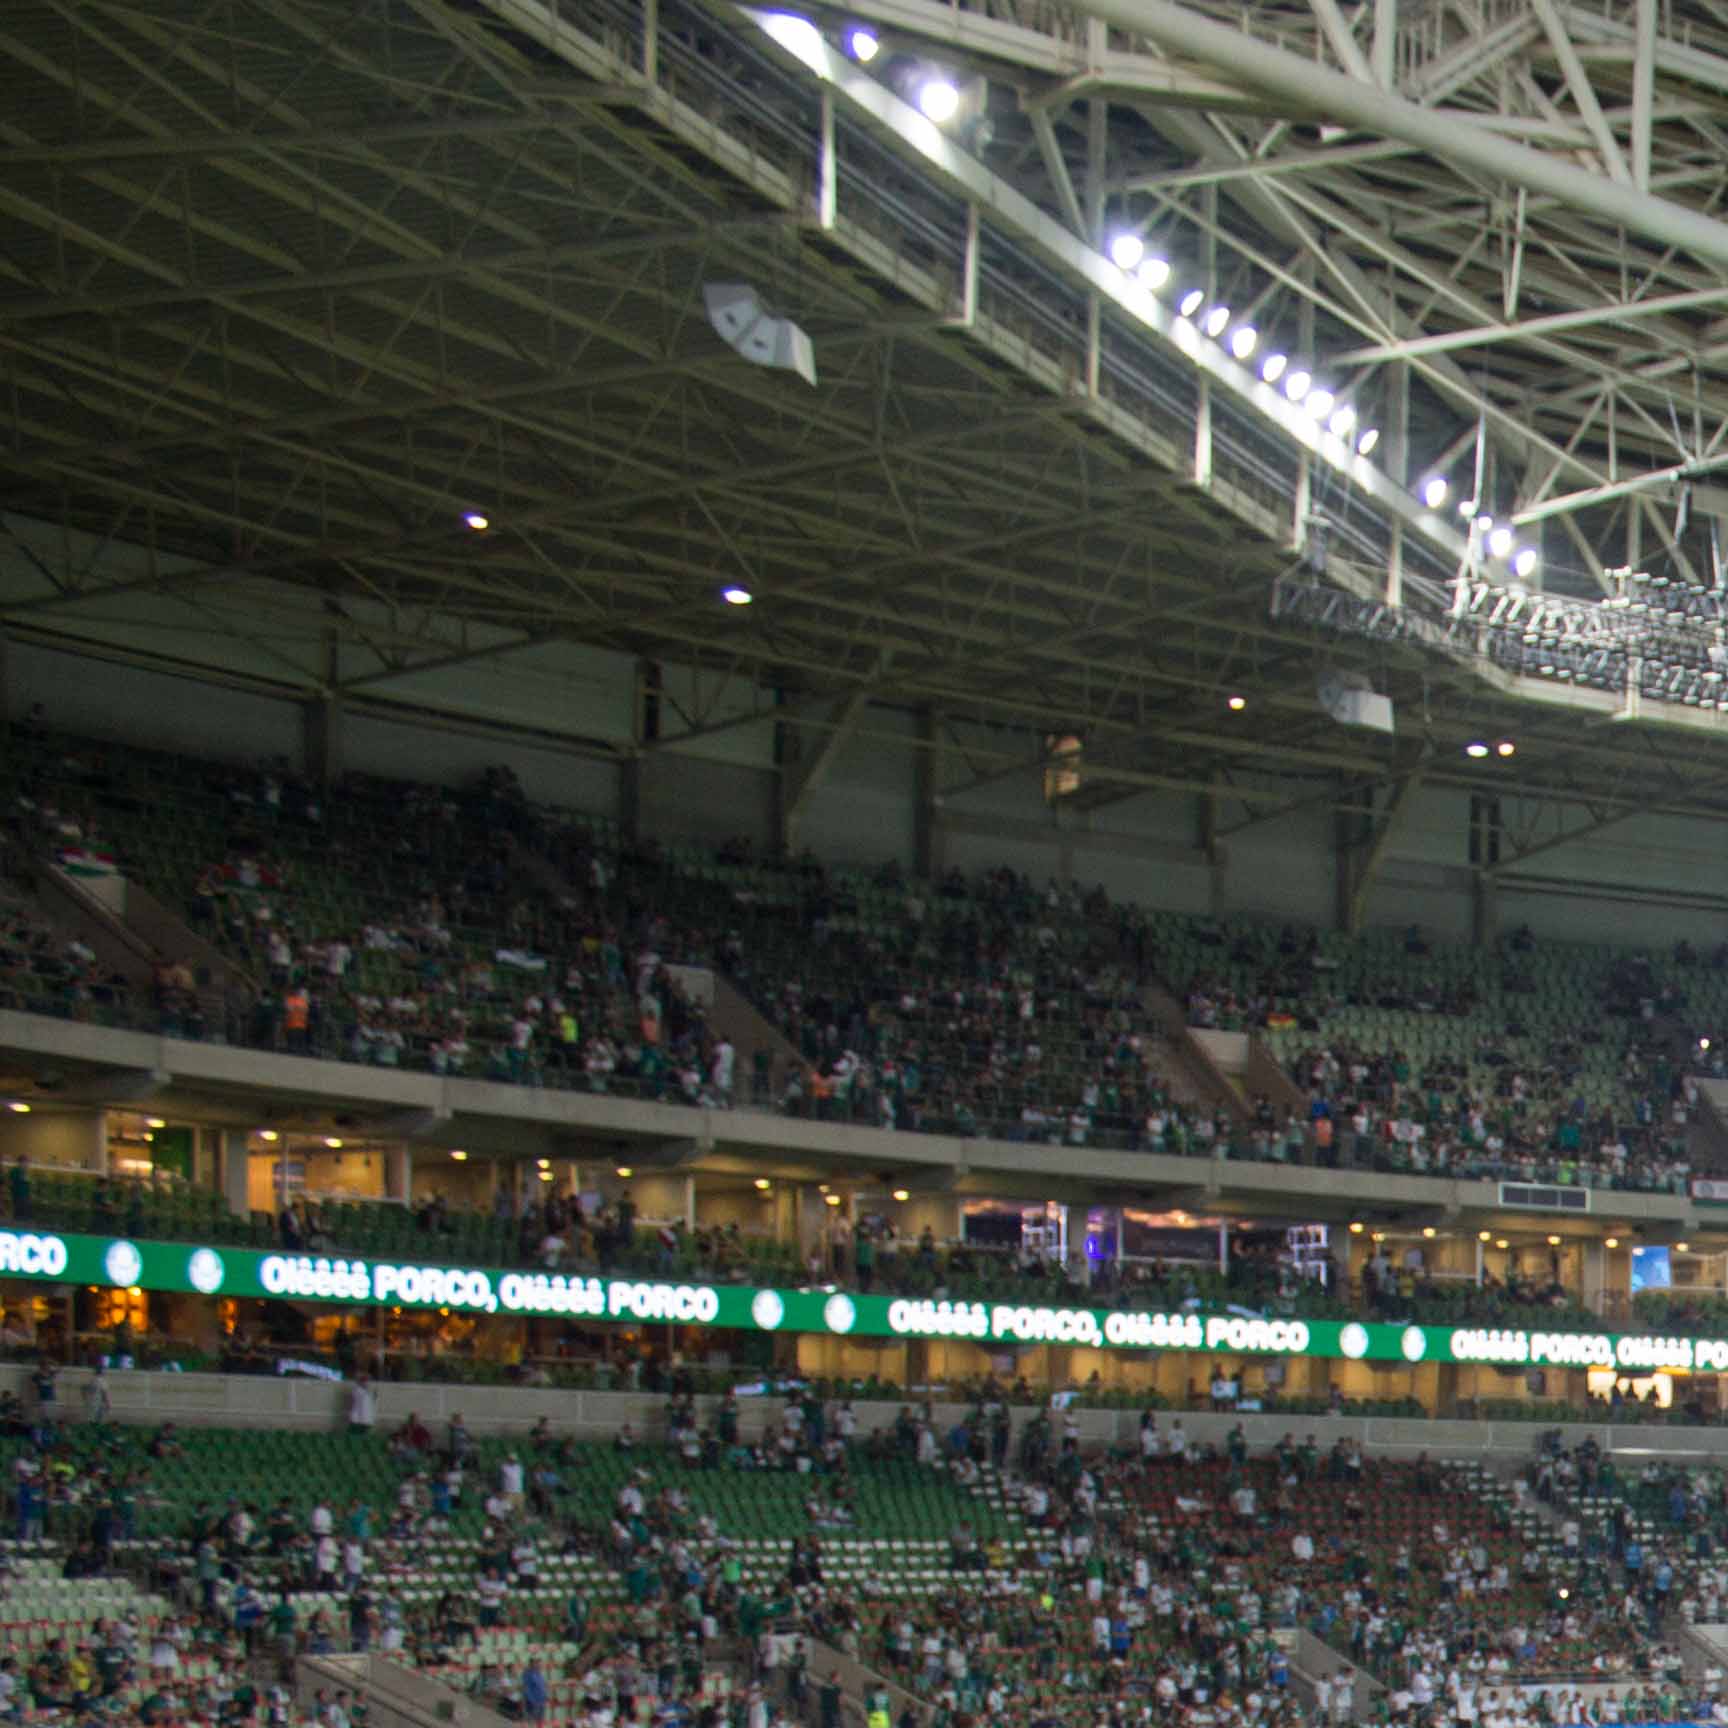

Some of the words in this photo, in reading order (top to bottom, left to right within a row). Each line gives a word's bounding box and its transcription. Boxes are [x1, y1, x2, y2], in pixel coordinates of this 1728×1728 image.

[374, 1265, 497, 1313] PORCO,
[608, 1281, 718, 1322] PORCO
[991, 1305, 1102, 1347] PORCO,
[1206, 1317, 1309, 1352] PORCO
